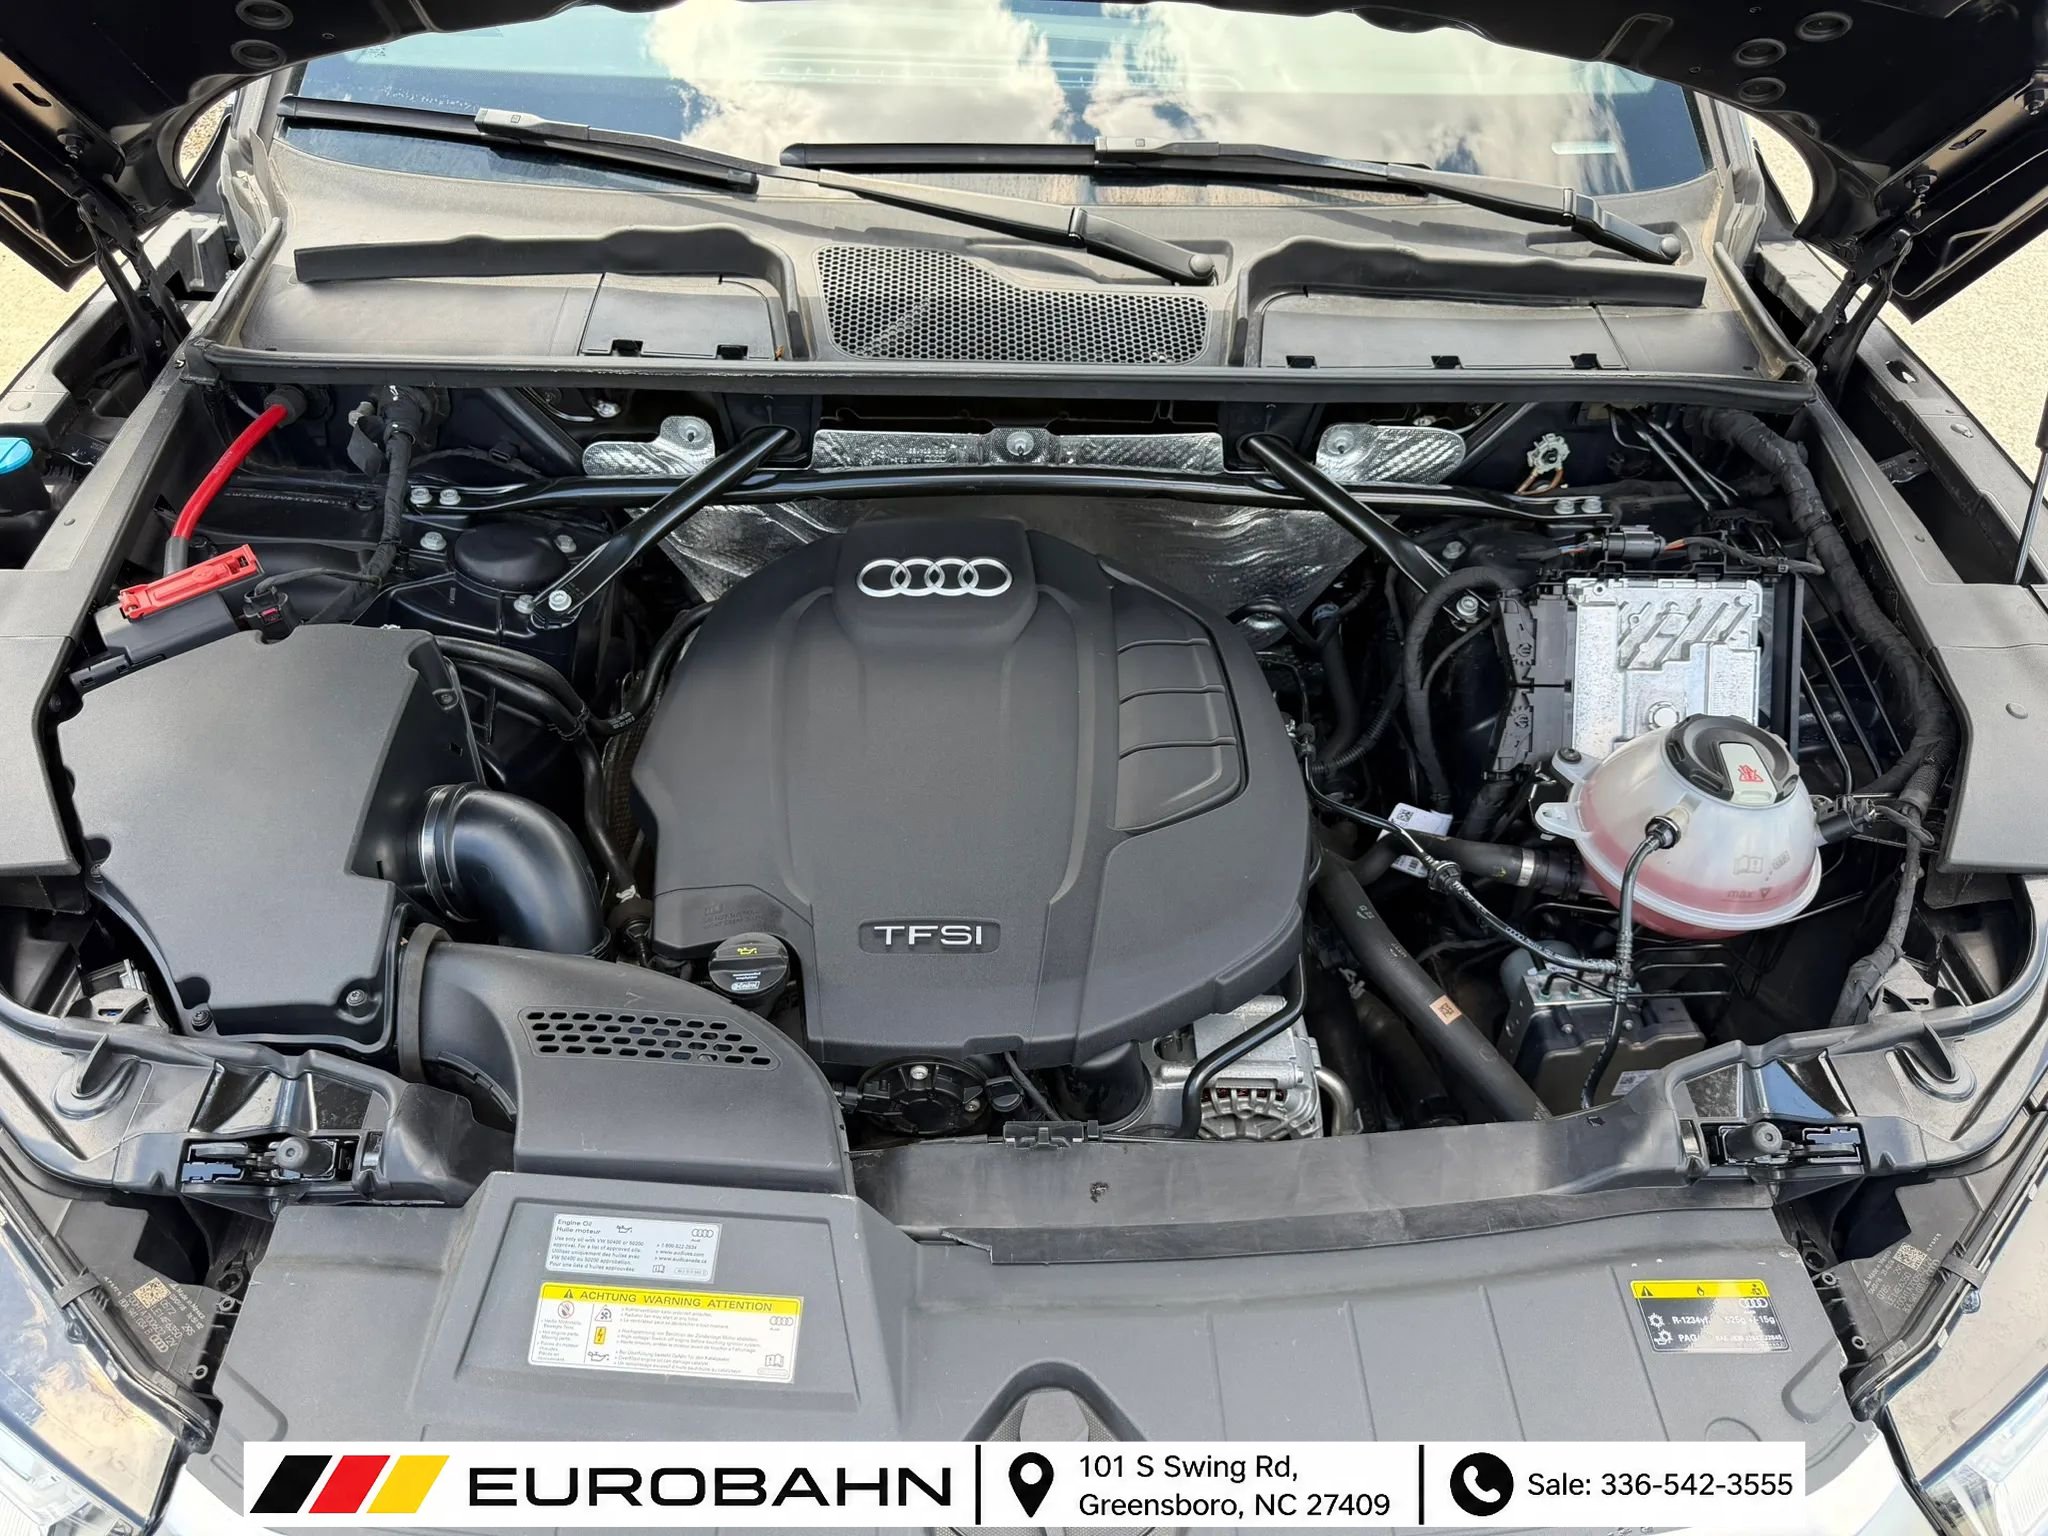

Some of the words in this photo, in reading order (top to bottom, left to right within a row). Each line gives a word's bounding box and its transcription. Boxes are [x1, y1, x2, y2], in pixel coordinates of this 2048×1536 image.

[874, 925, 982, 945] TFSI
[557, 1218, 580, 1226] Engine
[580, 1290, 636, 1302] ACHTUNG
[644, 1294, 702, 1307] WARNING
[707, 1298, 772, 1312] ATTENTION
